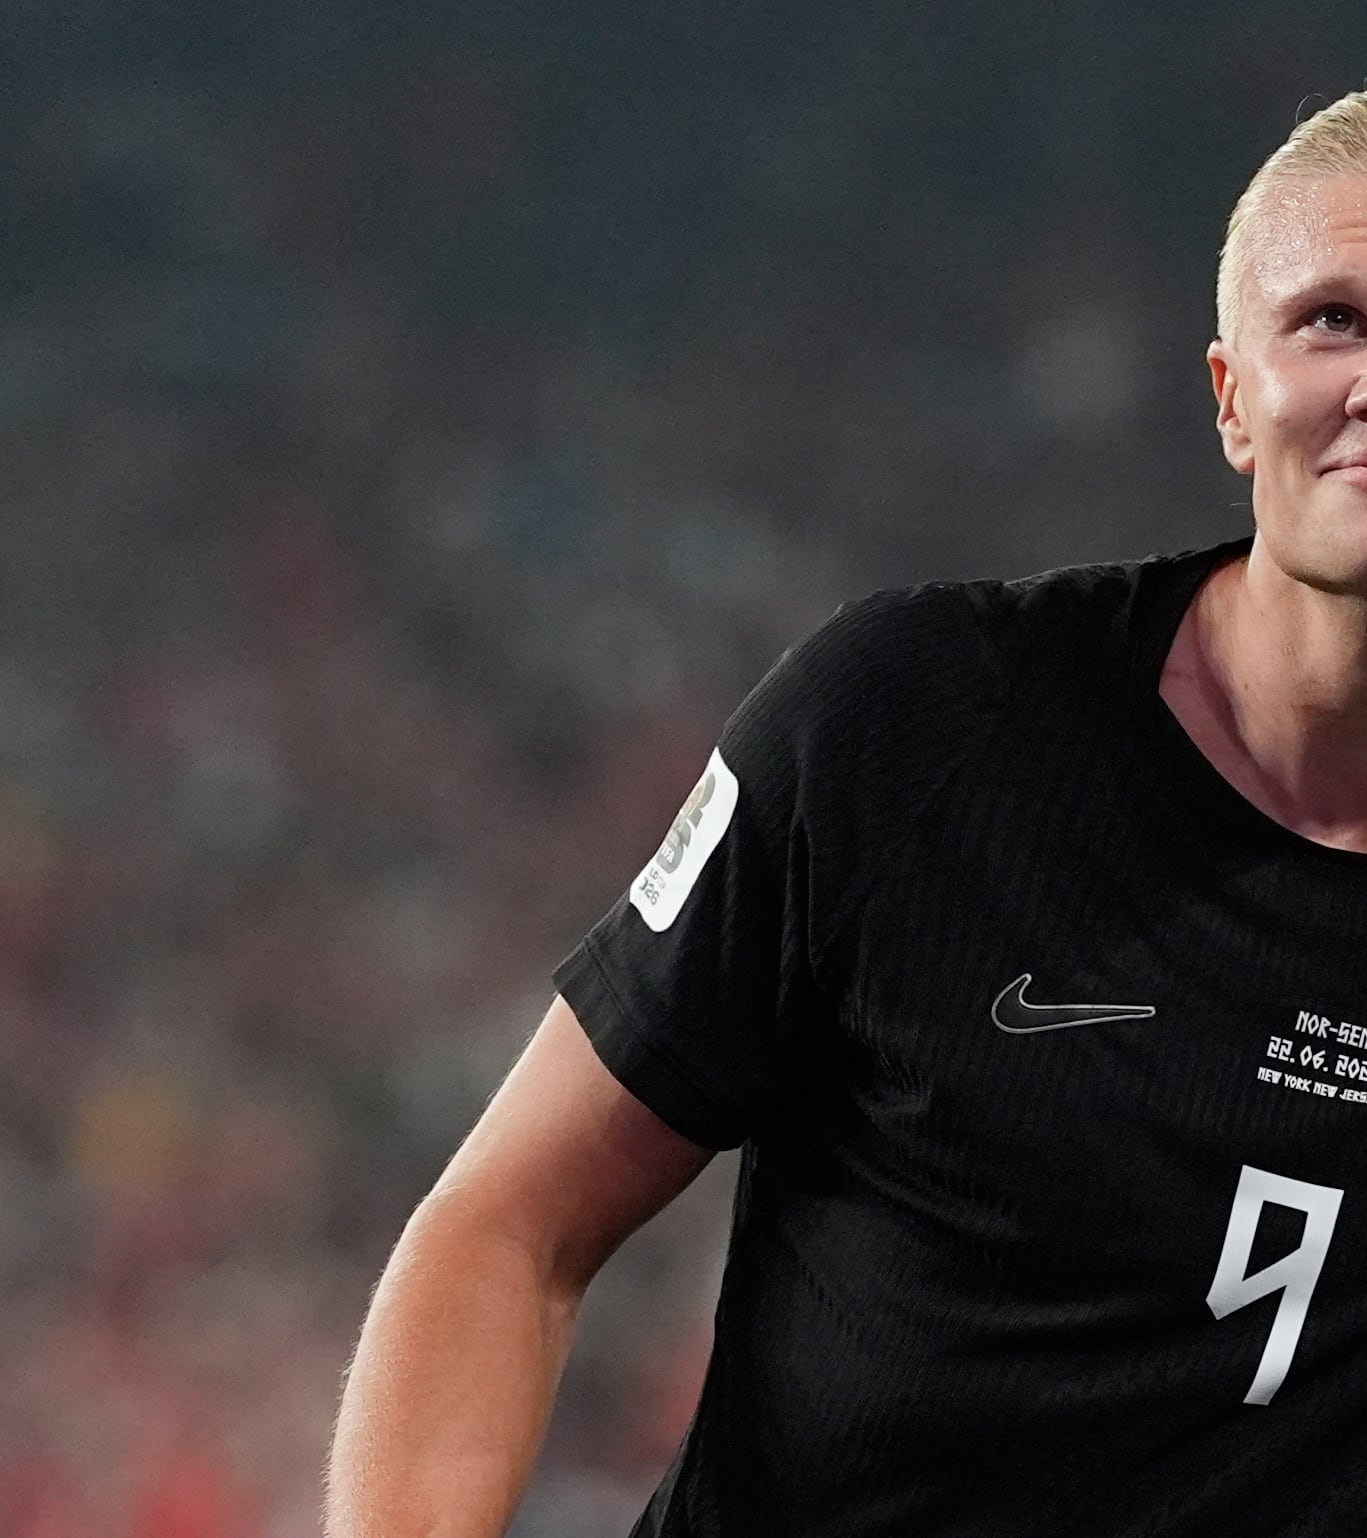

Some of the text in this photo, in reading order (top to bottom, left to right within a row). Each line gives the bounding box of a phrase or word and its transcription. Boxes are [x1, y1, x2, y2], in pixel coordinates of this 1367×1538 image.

[1257, 1067, 1282, 1084] NEW
[1285, 1074, 1312, 1092] YORK
[1313, 1082, 1338, 1097] NEW
[1206, 1164, 1344, 1405] 9
